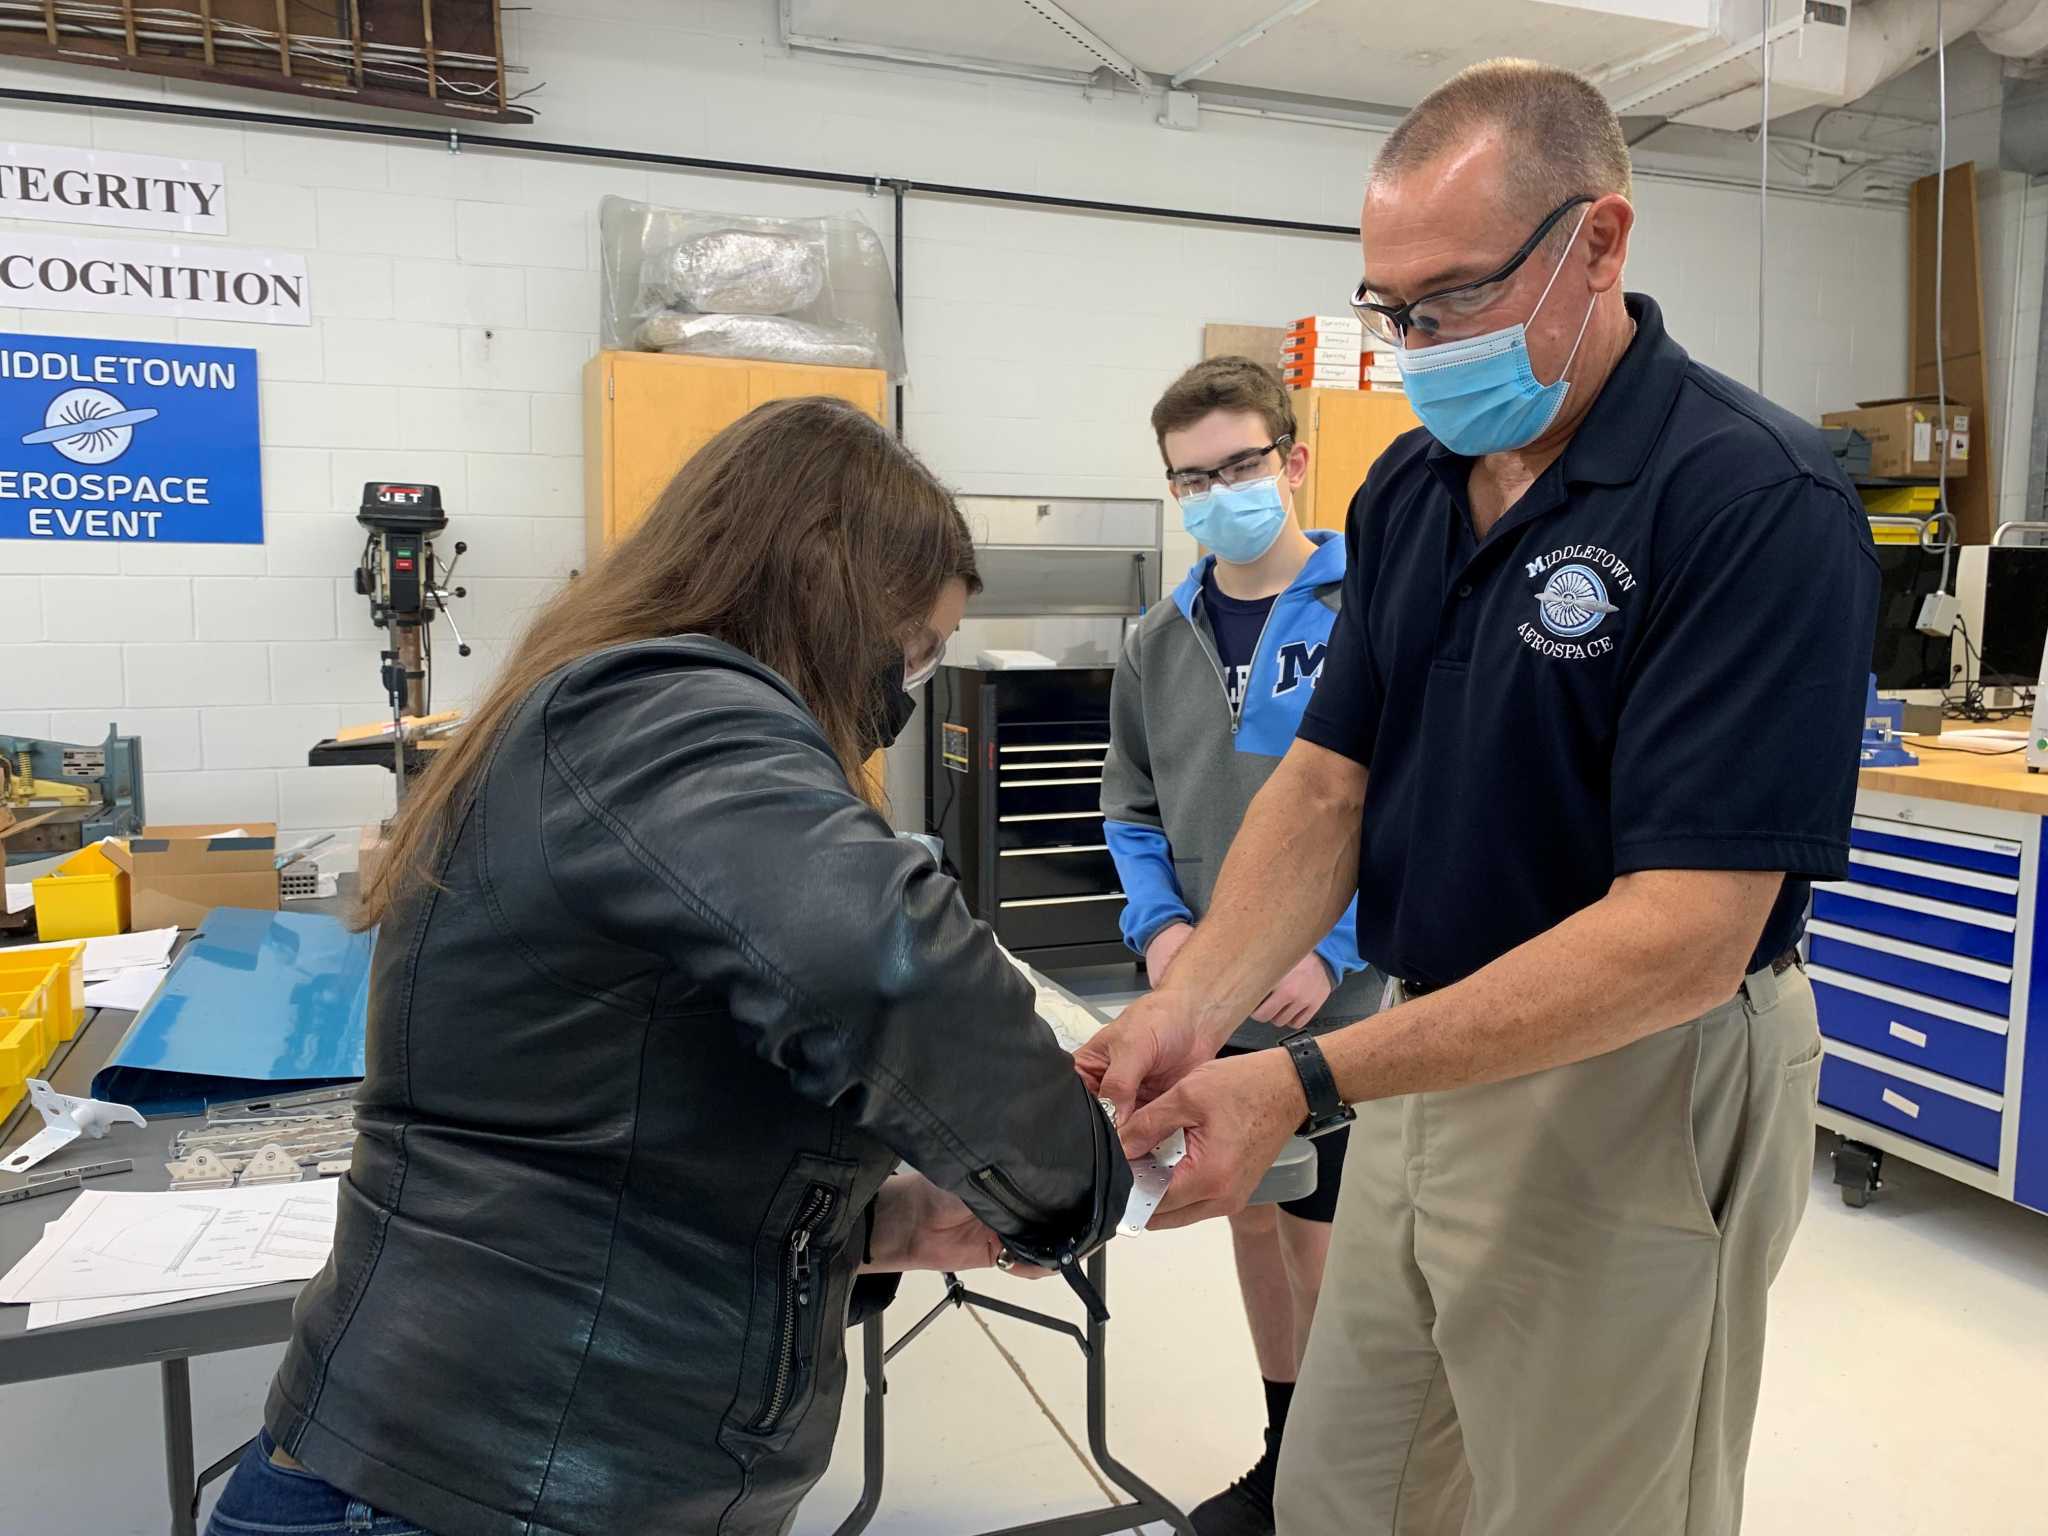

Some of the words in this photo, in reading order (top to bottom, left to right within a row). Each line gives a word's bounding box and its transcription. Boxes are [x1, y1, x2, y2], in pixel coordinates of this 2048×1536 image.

[0, 255, 303, 307] COGNITION
[0, 350, 237, 390] IDDLETOWN
[0, 471, 210, 505] EROSPACE
[379, 492, 422, 503] JET
[28, 508, 163, 538] EVENT
[1525, 545, 1637, 592] MIDDLETOWN
[1517, 622, 1614, 660] AEROSPACE
[1272, 641, 1328, 697] M
